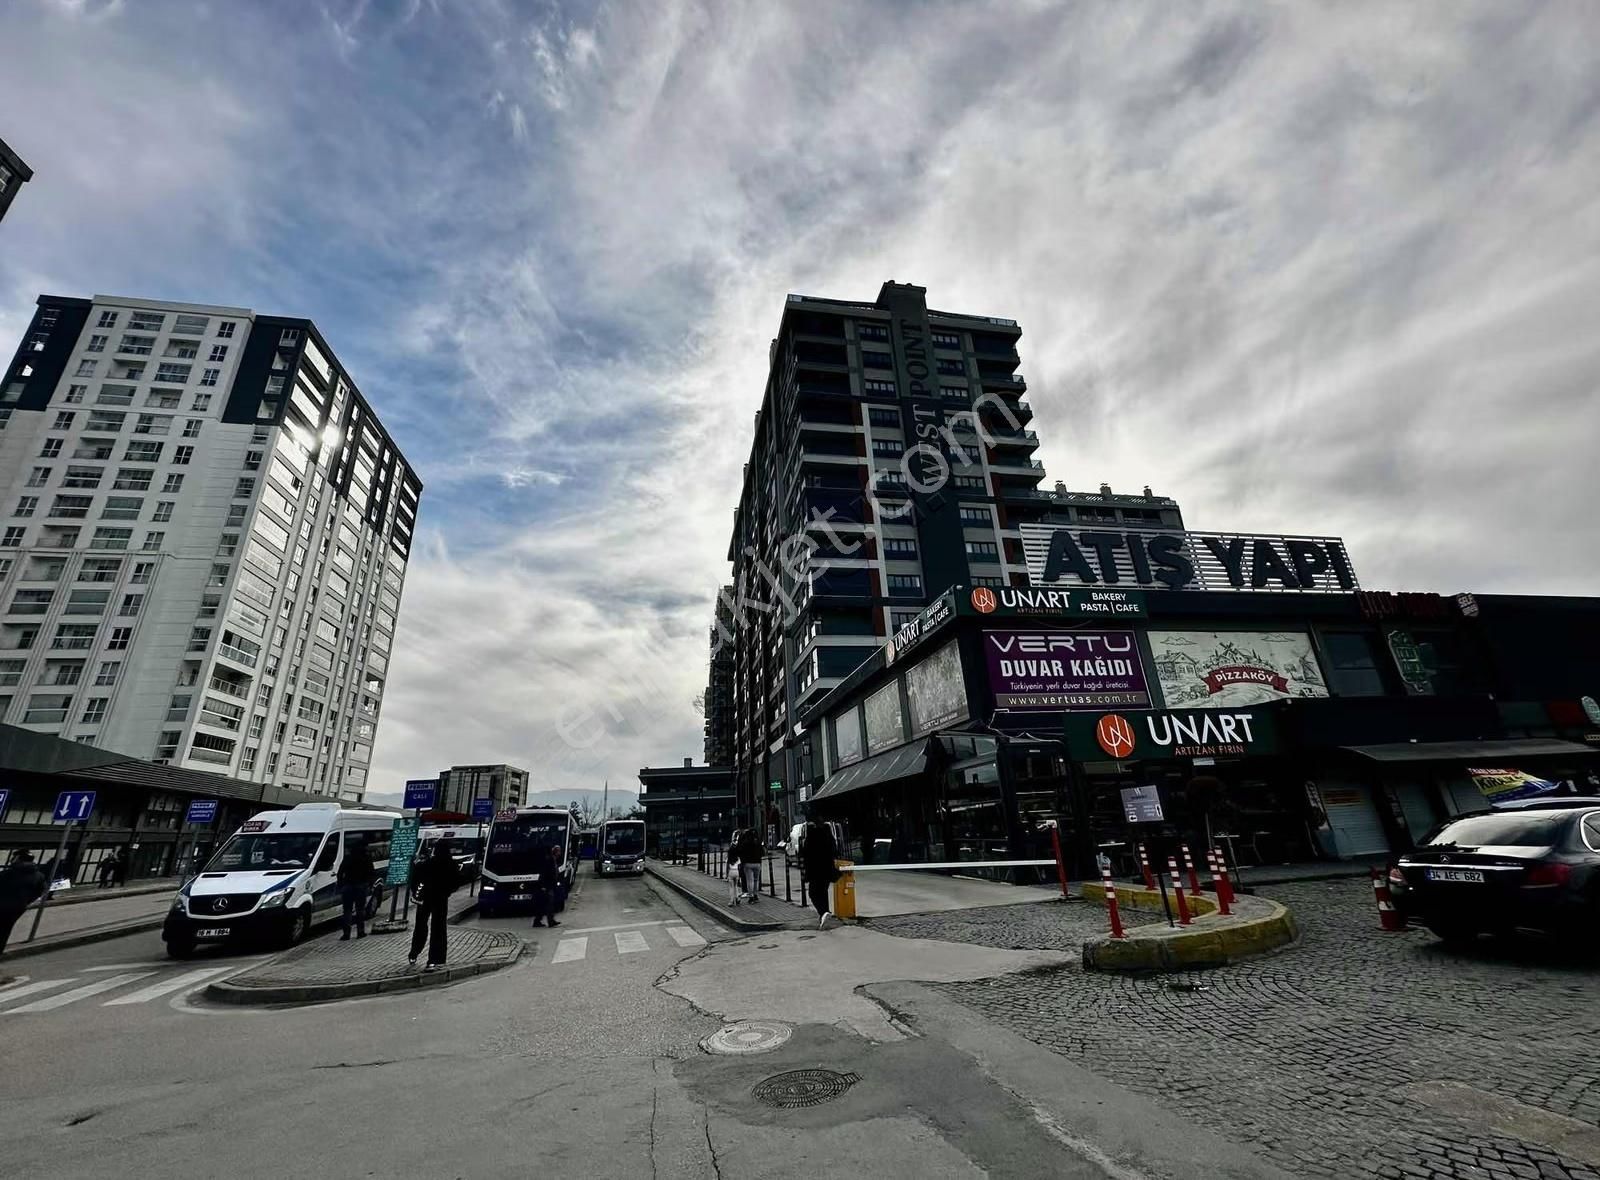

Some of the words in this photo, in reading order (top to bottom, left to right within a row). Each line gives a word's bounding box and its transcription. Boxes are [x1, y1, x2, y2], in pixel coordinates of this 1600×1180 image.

[901, 319, 932, 398] POINT
[912, 404, 946, 485] WEST
[1202, 537, 1355, 589] YAPI
[1001, 590, 1071, 608] UNART
[1092, 592, 1127, 601] BAKERY
[926, 599, 943, 618] BAKERY
[937, 606, 949, 621] CAFE
[1080, 603, 1110, 612] PASTA
[1117, 603, 1140, 612] CAFE
[894, 619, 920, 651] UNART
[990, 635, 1131, 652] VERTU
[1000, 659, 1064, 677] DUVAR
[1071, 656, 1134, 676] KAĞIDI
[1010, 682, 1043, 691] Türkiyenin
[1046, 682, 1060, 691] yerli
[1008, 694, 1137, 705] www.vertuas.com.tr
[1147, 713, 1254, 746] UNART
[1175, 746, 1215, 756] ARTIZAN
[1219, 745, 1244, 754] FIRIN
